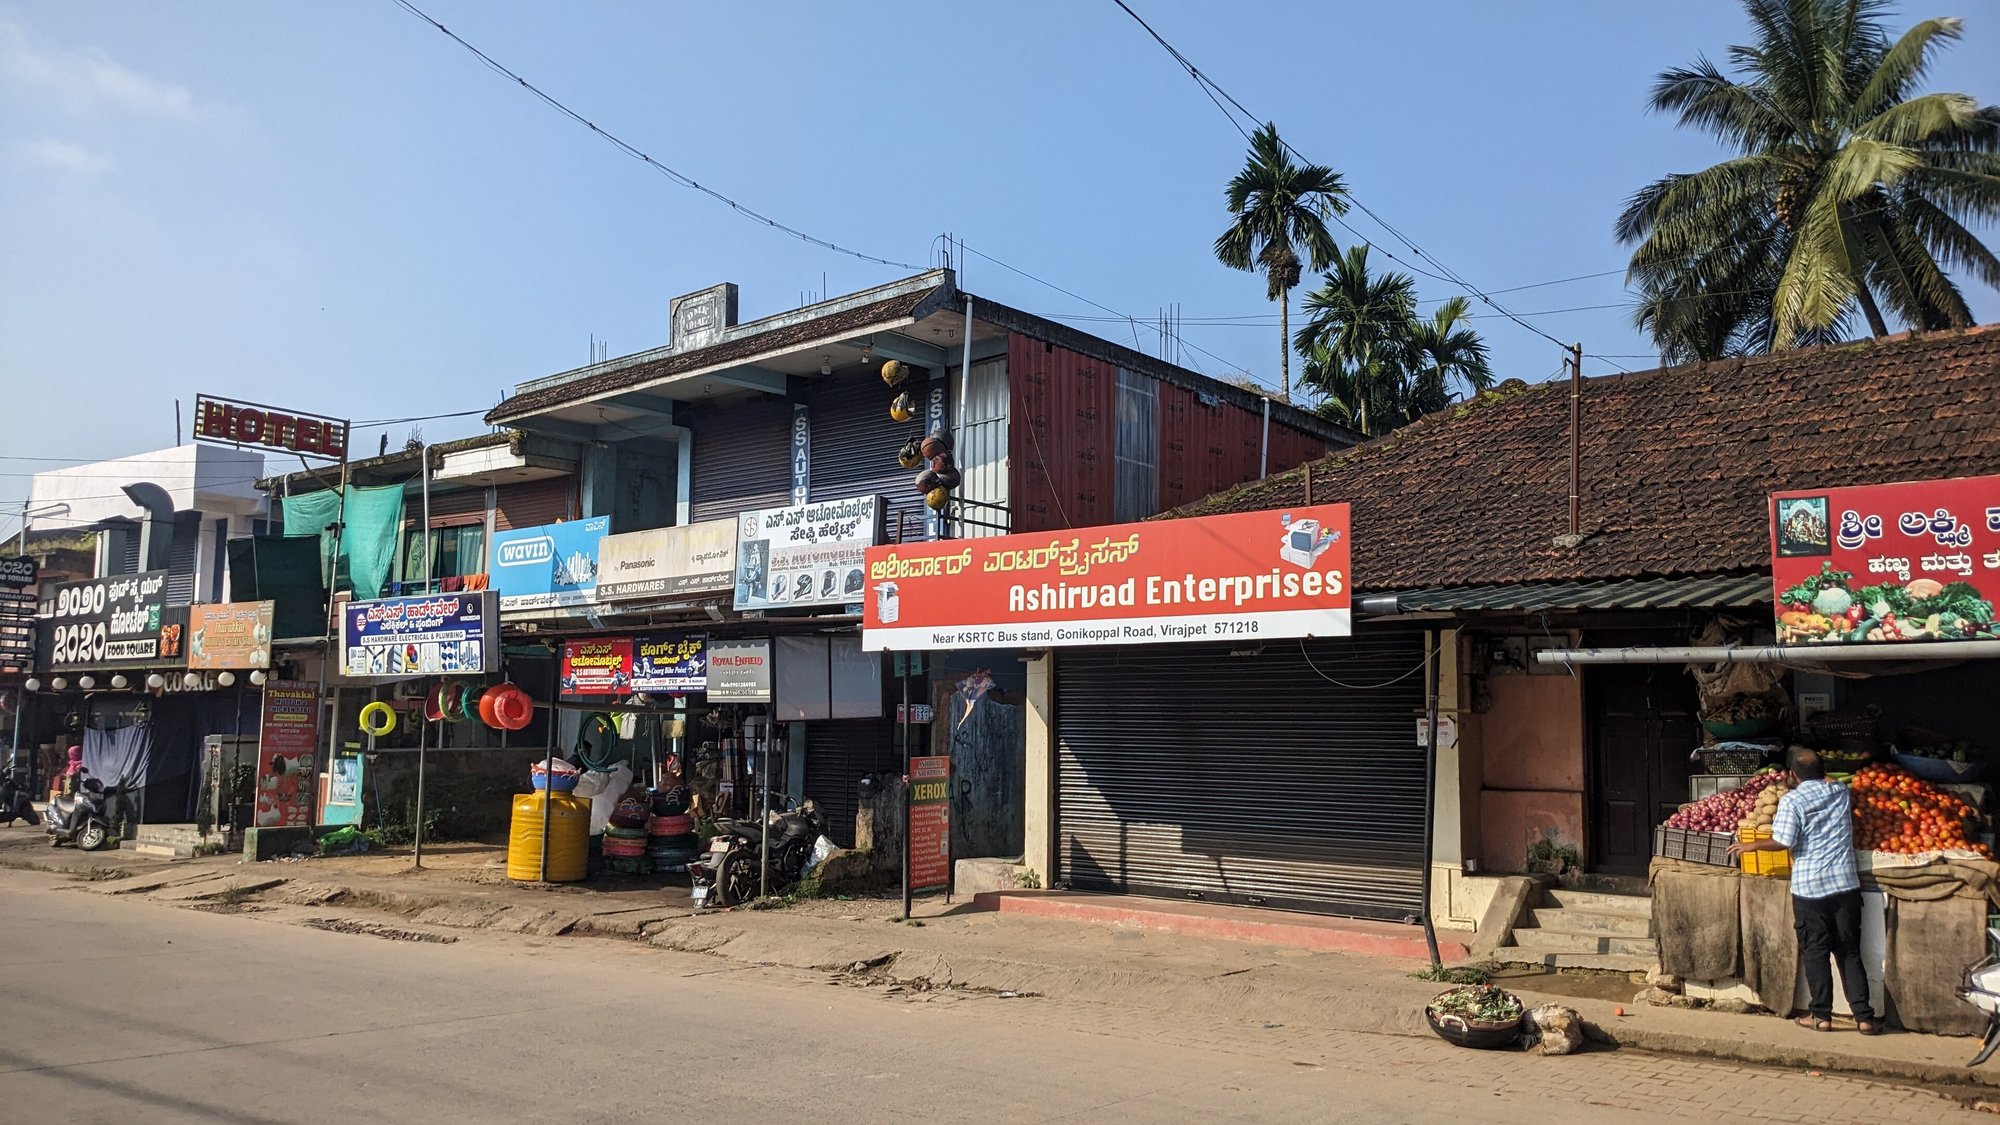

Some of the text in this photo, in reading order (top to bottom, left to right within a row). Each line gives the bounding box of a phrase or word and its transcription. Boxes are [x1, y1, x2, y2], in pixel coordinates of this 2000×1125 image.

[202, 401, 344, 457] HOTEL
[1837, 508, 1882, 550] ಶ್ರೀ
[504, 541, 548, 561] wavin
[620, 557, 656, 571] Panasonic
[871, 548, 973, 580] ಆಶೀರ್ವಾದ್
[1867, 554, 1911, 581] ಹಣ್ಣು
[1920, 551, 1973, 576] ಮತ್ತು
[600, 585, 614, 596] S.S.
[616, 580, 665, 594] HARDWARES
[1009, 568, 1342, 612] Ashirvad Enterprises
[371, 635, 398, 643] HARDWARE
[399, 633, 431, 642] ELECTRICAL
[436, 632, 463, 640] PLUMBING
[932, 620, 1259, 644] Near KSRTC Bus stand, Gonikoppal Road, Virajpet 571218
[53, 622, 106, 664] 2020
[107, 640, 154, 655] FOOD SQUARE
[640, 640, 702, 660] ಕೂರ್ಗ್ ಬೈಕ್
[712, 655, 763, 666] ROYAL ENFIELD
[268, 689, 315, 699] Thavakkal
[914, 782, 947, 801] XEROX
